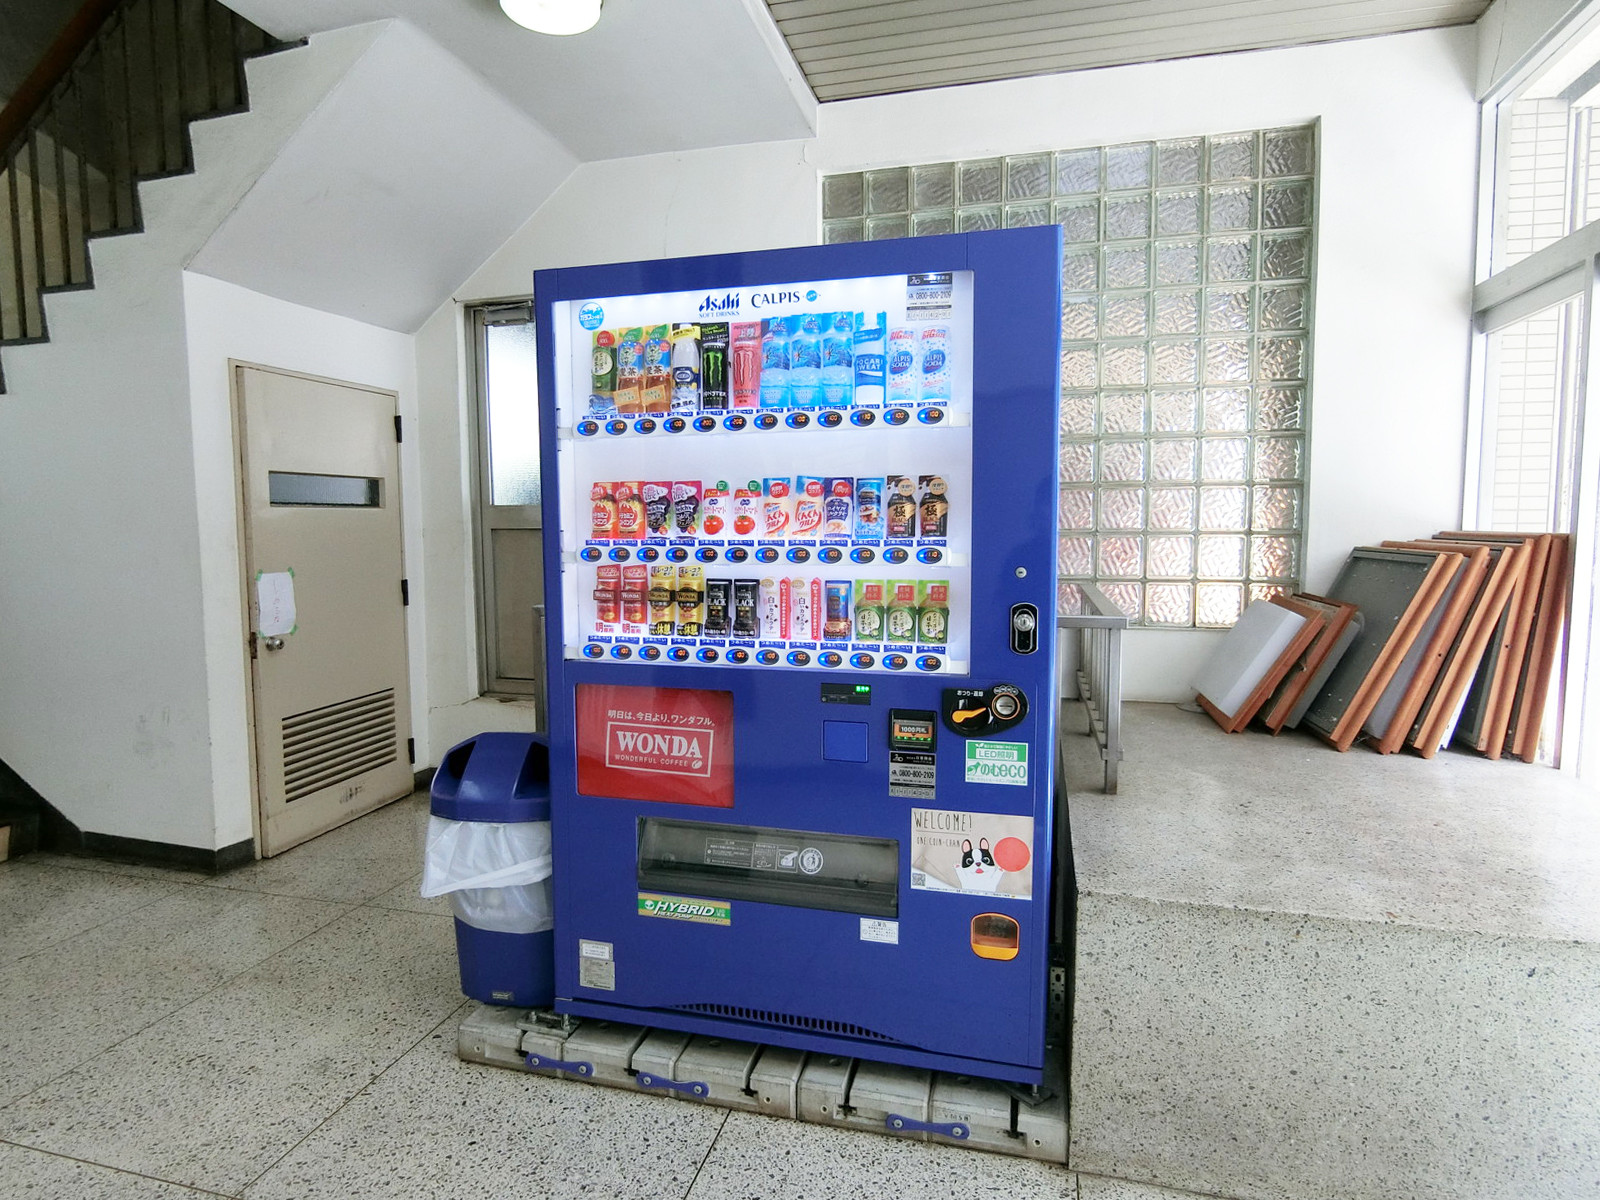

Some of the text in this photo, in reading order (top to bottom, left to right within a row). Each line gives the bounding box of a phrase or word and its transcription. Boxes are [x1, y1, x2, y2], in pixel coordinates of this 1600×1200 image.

[699, 291, 800, 312] Asahi CALPIS
[607, 709, 716, 727] 明日は、今日より、ワンダフル。
[616, 731, 703, 759] WONDA
[614, 754, 688, 767] WONDERFUL COFFEE
[978, 750, 1014, 760] LED照明
[914, 811, 972, 832] WELCOME!
[917, 836, 926, 845] ONE
[654, 901, 715, 917] HYBRID
